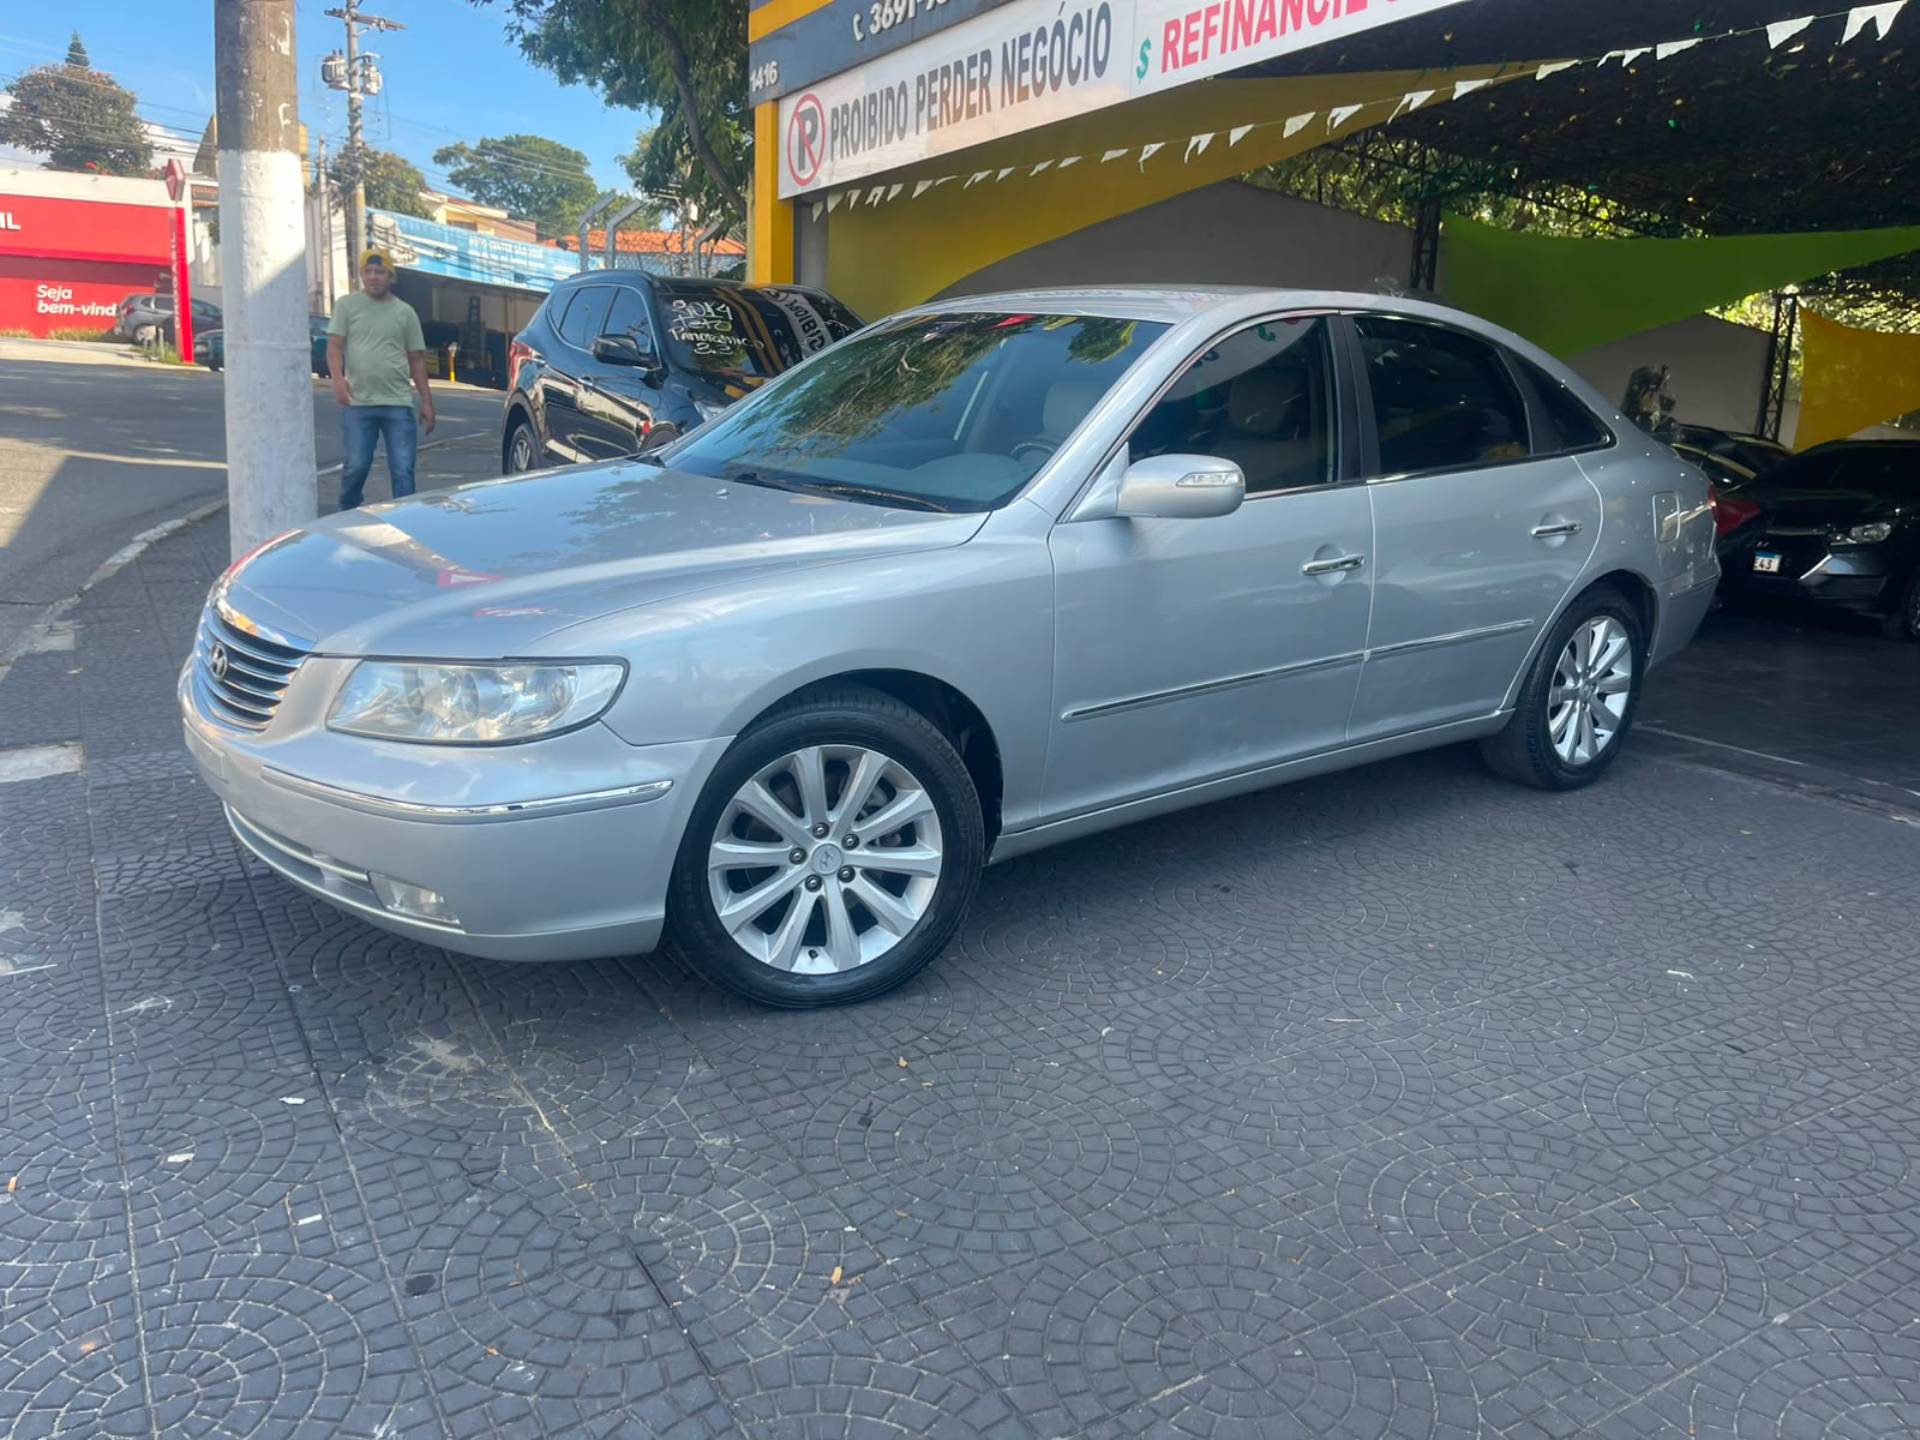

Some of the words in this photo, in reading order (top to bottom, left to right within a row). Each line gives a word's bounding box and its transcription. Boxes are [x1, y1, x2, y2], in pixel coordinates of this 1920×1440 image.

[1161, 0, 1368, 73] REFINANC
[831, 80, 908, 161] PROIBIDO
[915, 48, 992, 136] PERDER
[1001, 1, 1112, 109] NEGÓCIO
[36, 284, 72, 301] Seja
[37, 300, 119, 317] bem-vind
